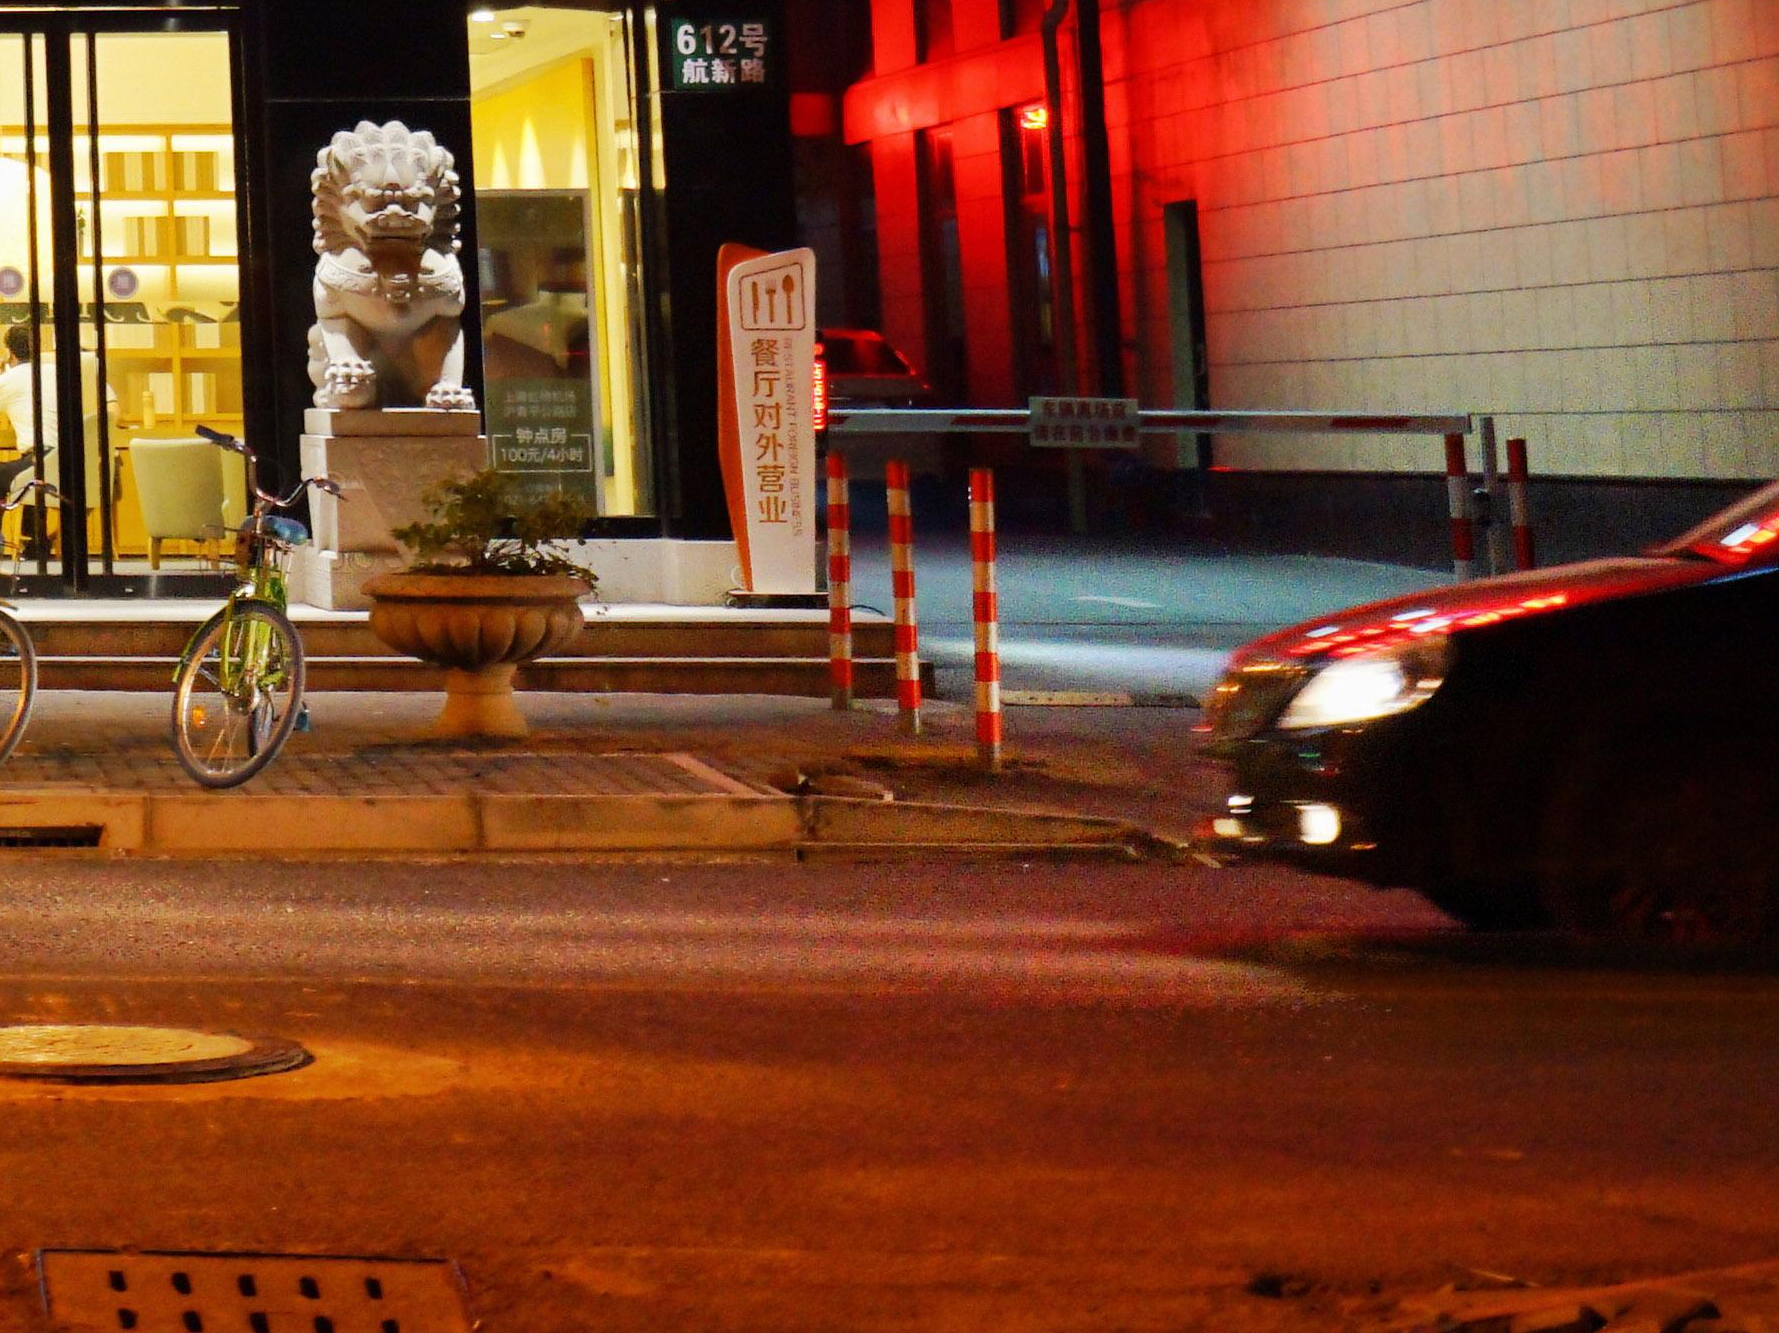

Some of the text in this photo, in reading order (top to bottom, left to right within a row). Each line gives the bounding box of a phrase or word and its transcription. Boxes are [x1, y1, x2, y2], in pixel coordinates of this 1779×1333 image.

[676, 23, 768, 58] 612号
[681, 58, 765, 85] 航新路
[515, 427, 567, 444] 钟点房
[750, 338, 788, 524] 餐厅对外营业
[500, 446, 584, 464] 100元/4小时
